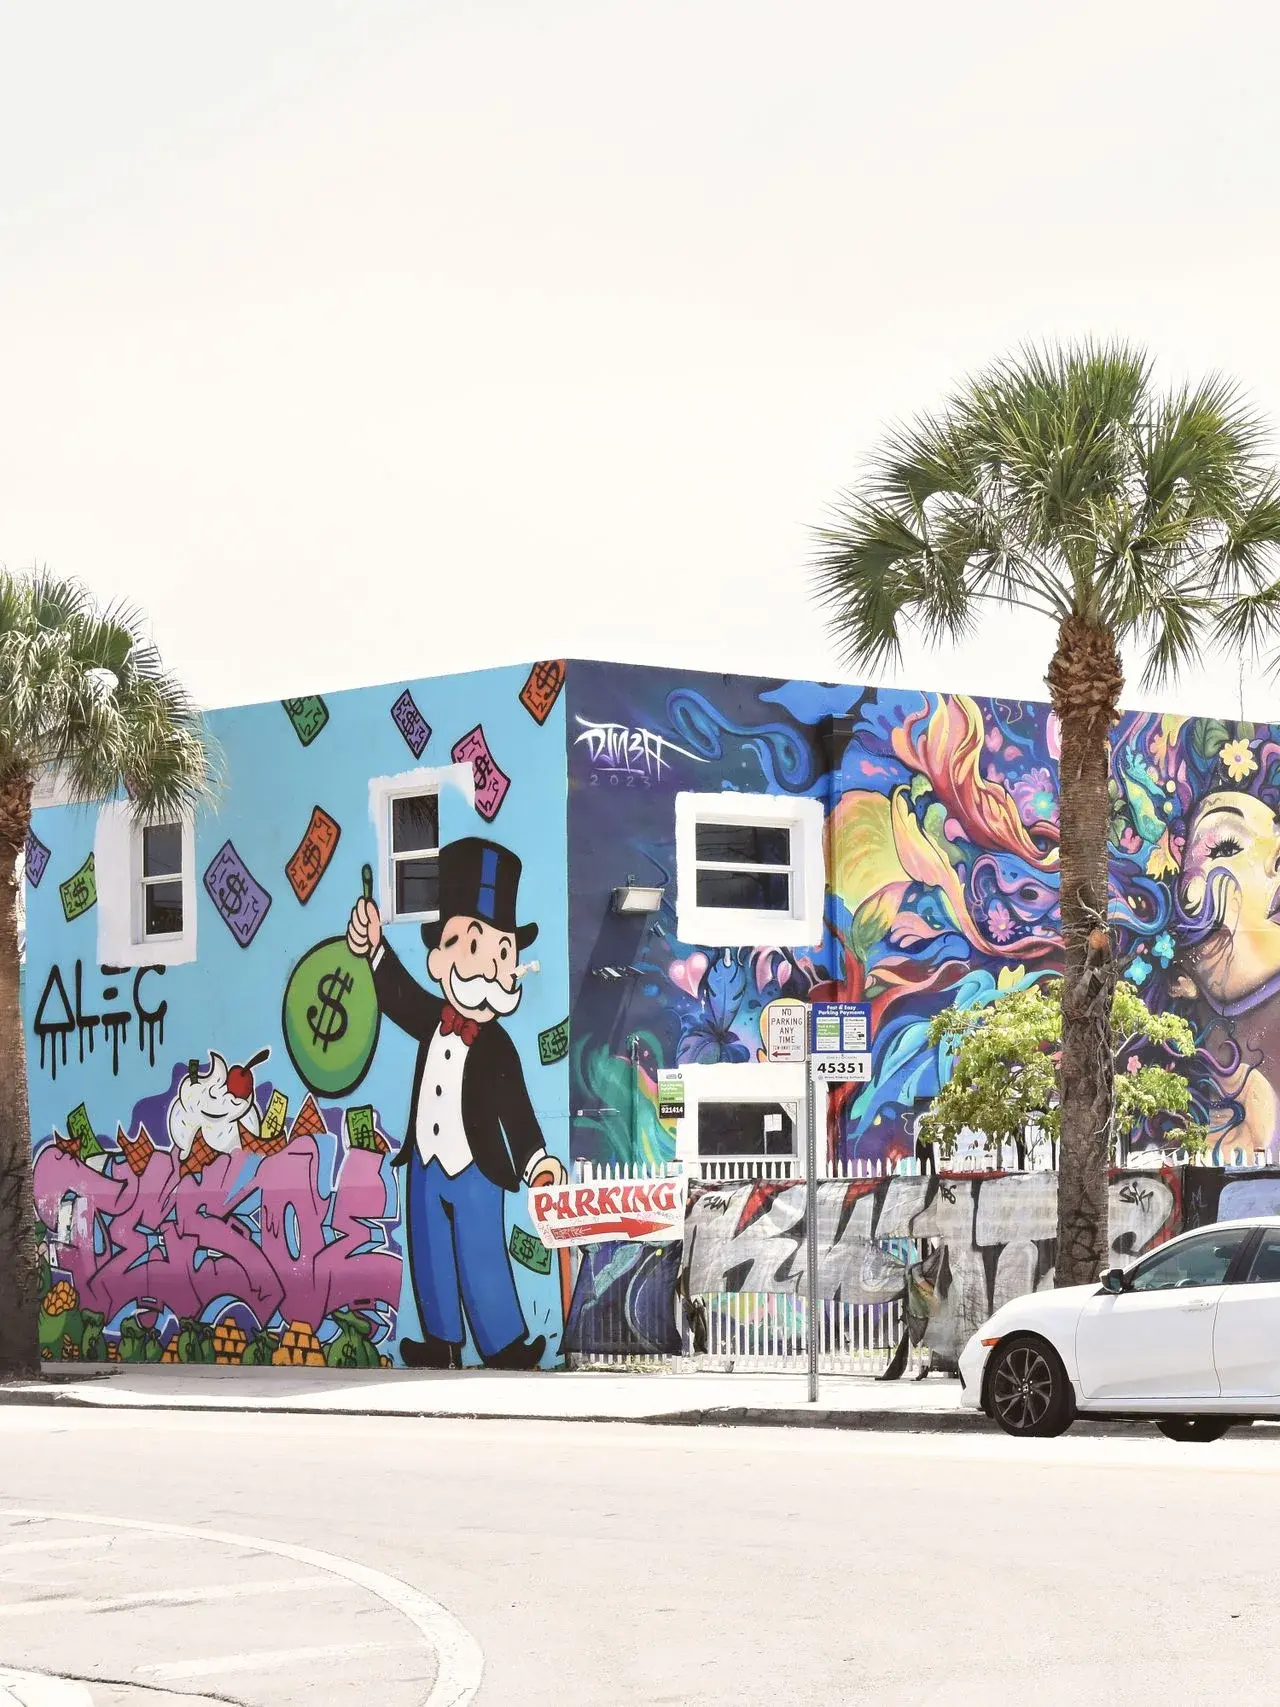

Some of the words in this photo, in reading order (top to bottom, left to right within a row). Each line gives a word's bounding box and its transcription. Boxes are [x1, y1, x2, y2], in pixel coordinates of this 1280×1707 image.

[589, 773, 652, 788] 2023
[781, 1008, 792, 1016] NO
[33, 958, 168, 1080] ALEC
[771, 1017, 803, 1026] PARKING
[779, 1027, 794, 1035] ANY
[778, 1036, 796, 1044] TIME
[816, 1062, 864, 1074] 45351
[660, 1106, 684, 1114] 921414
[534, 1182, 677, 1222] PARKING
